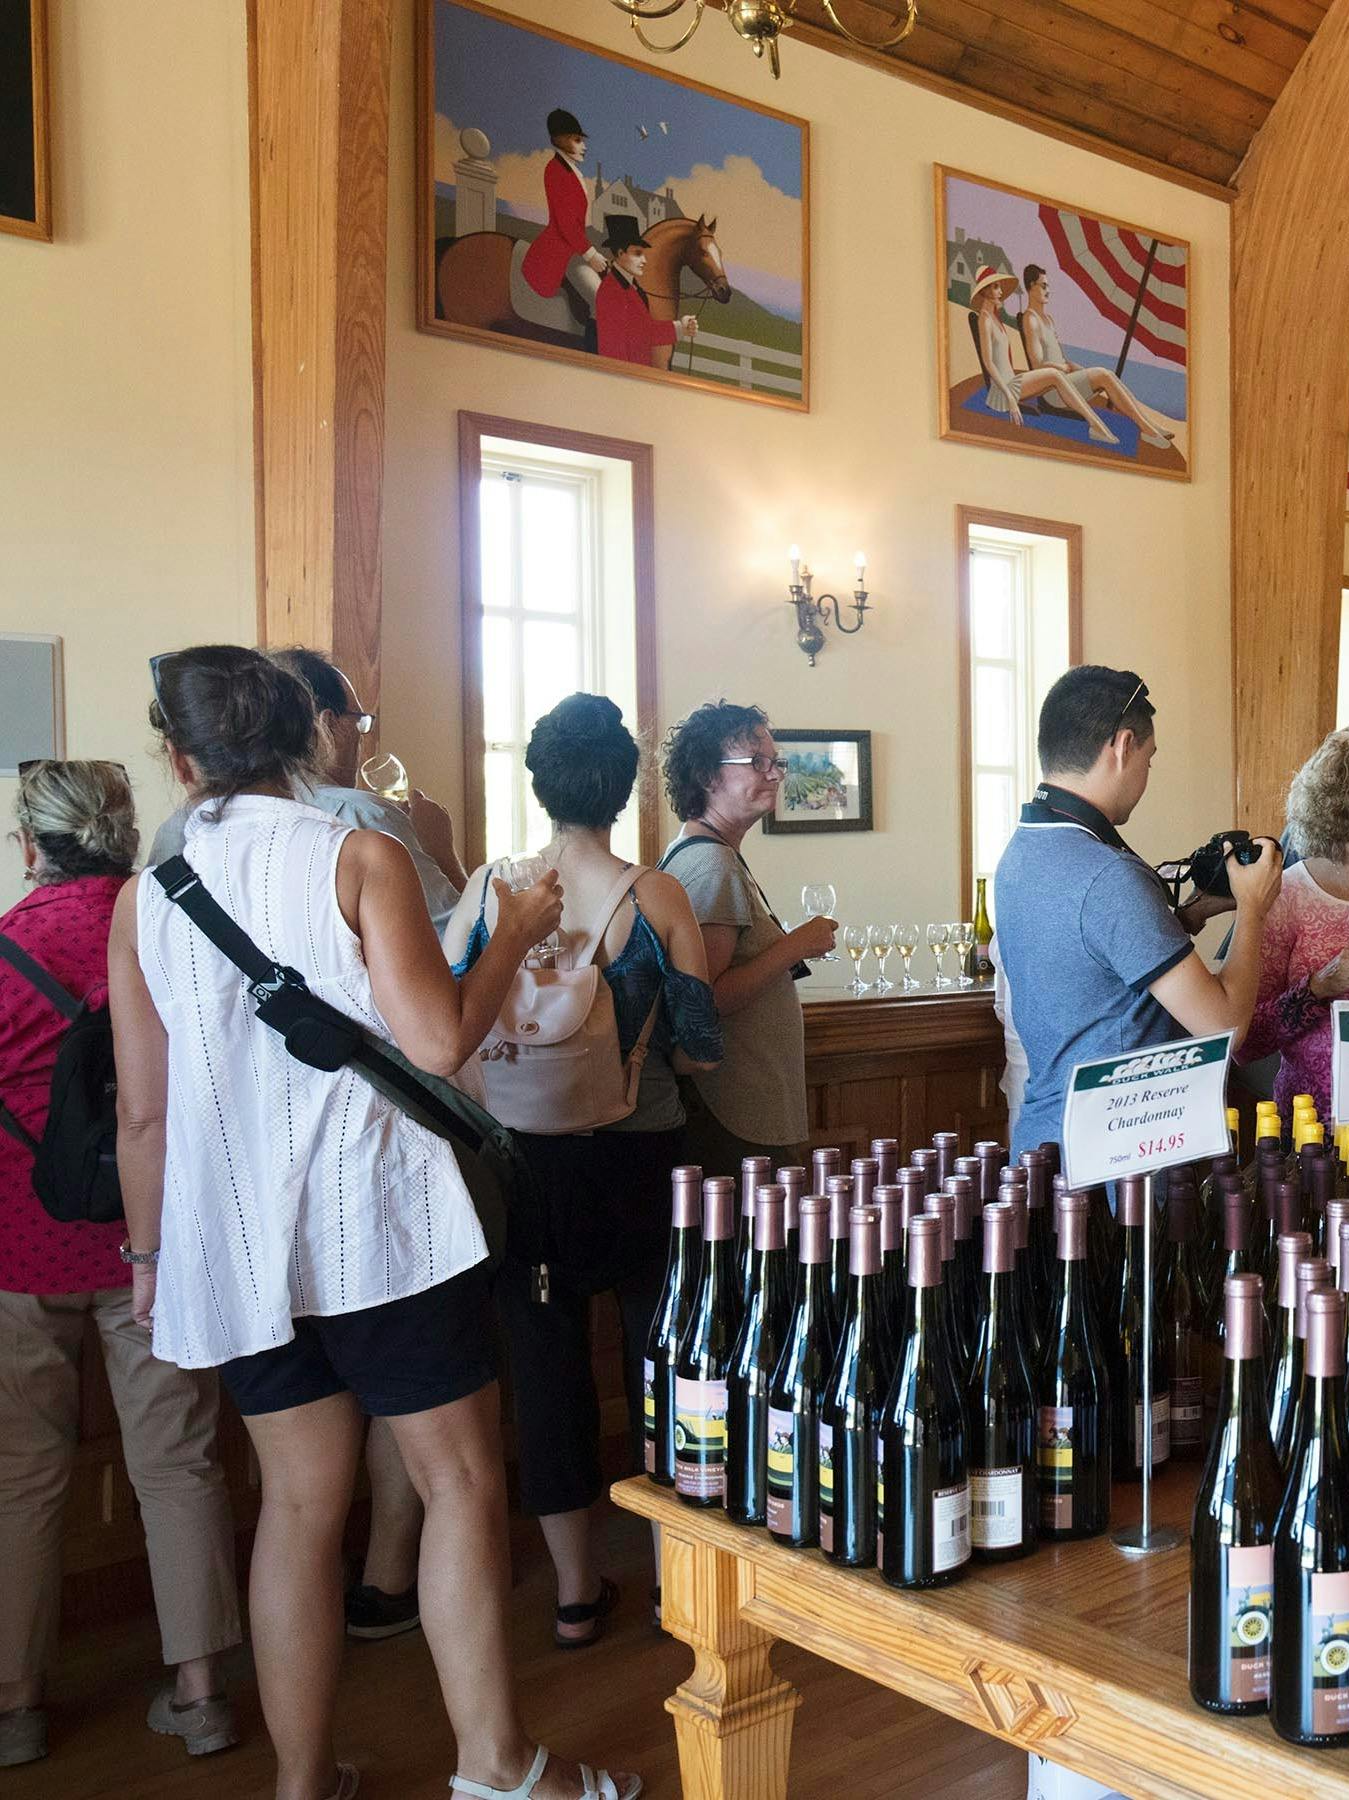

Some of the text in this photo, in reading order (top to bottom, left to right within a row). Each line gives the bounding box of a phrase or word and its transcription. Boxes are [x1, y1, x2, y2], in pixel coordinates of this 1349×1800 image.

[1112, 1063, 1191, 1086] DUCK WALK
[1106, 1083, 1189, 1112] 2013 Reserve
[1107, 1105, 1186, 1132] Chardonnay
[1108, 1132, 1185, 1164] 750ml $14.95
[1240, 1663, 1264, 1671] DUCK
[1324, 1693, 1348, 1702] DUCK
